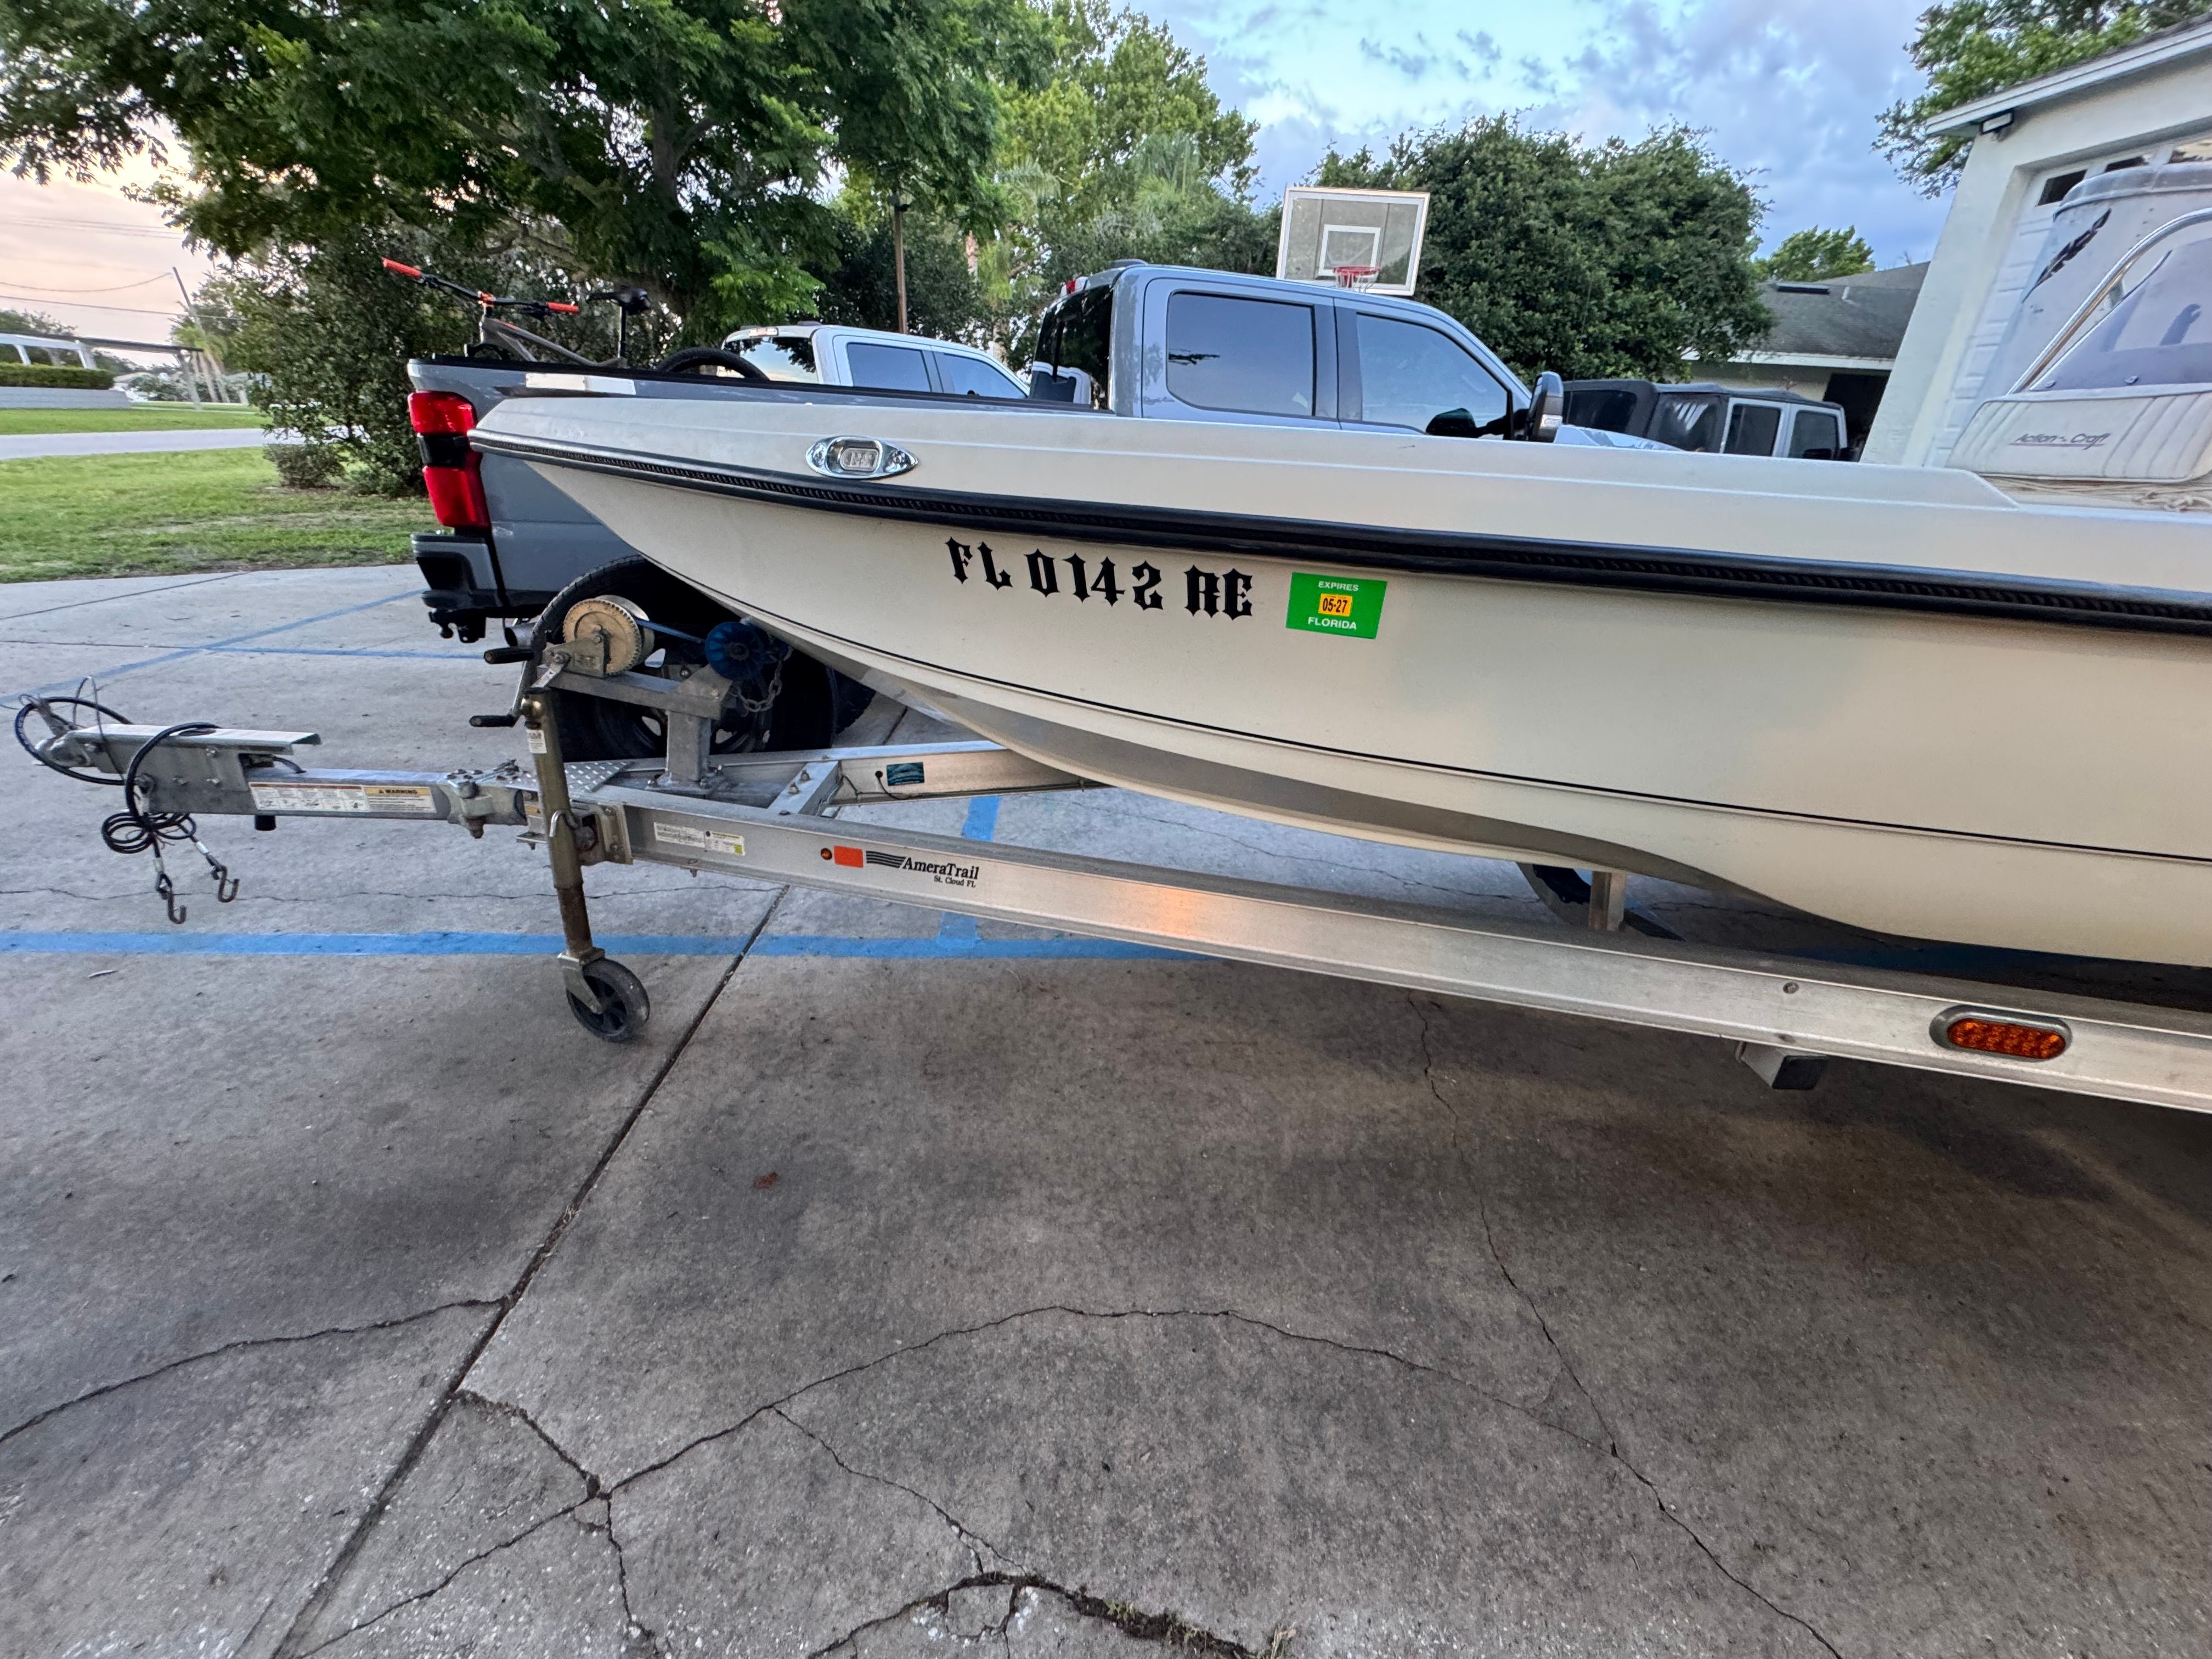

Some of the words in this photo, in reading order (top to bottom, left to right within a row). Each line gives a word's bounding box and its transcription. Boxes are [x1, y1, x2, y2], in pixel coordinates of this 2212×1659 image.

[945, 537, 1013, 590] FL
[1024, 548, 1164, 611] 0142
[1318, 581, 1359, 591] EXPIRES
[1322, 597, 1348, 613] 05-27
[1308, 616, 1357, 630] FLORIDA
[902, 857, 980, 879] AmeraTrail
[945, 876, 964, 887] Cloud
[967, 879, 976, 888] FL
